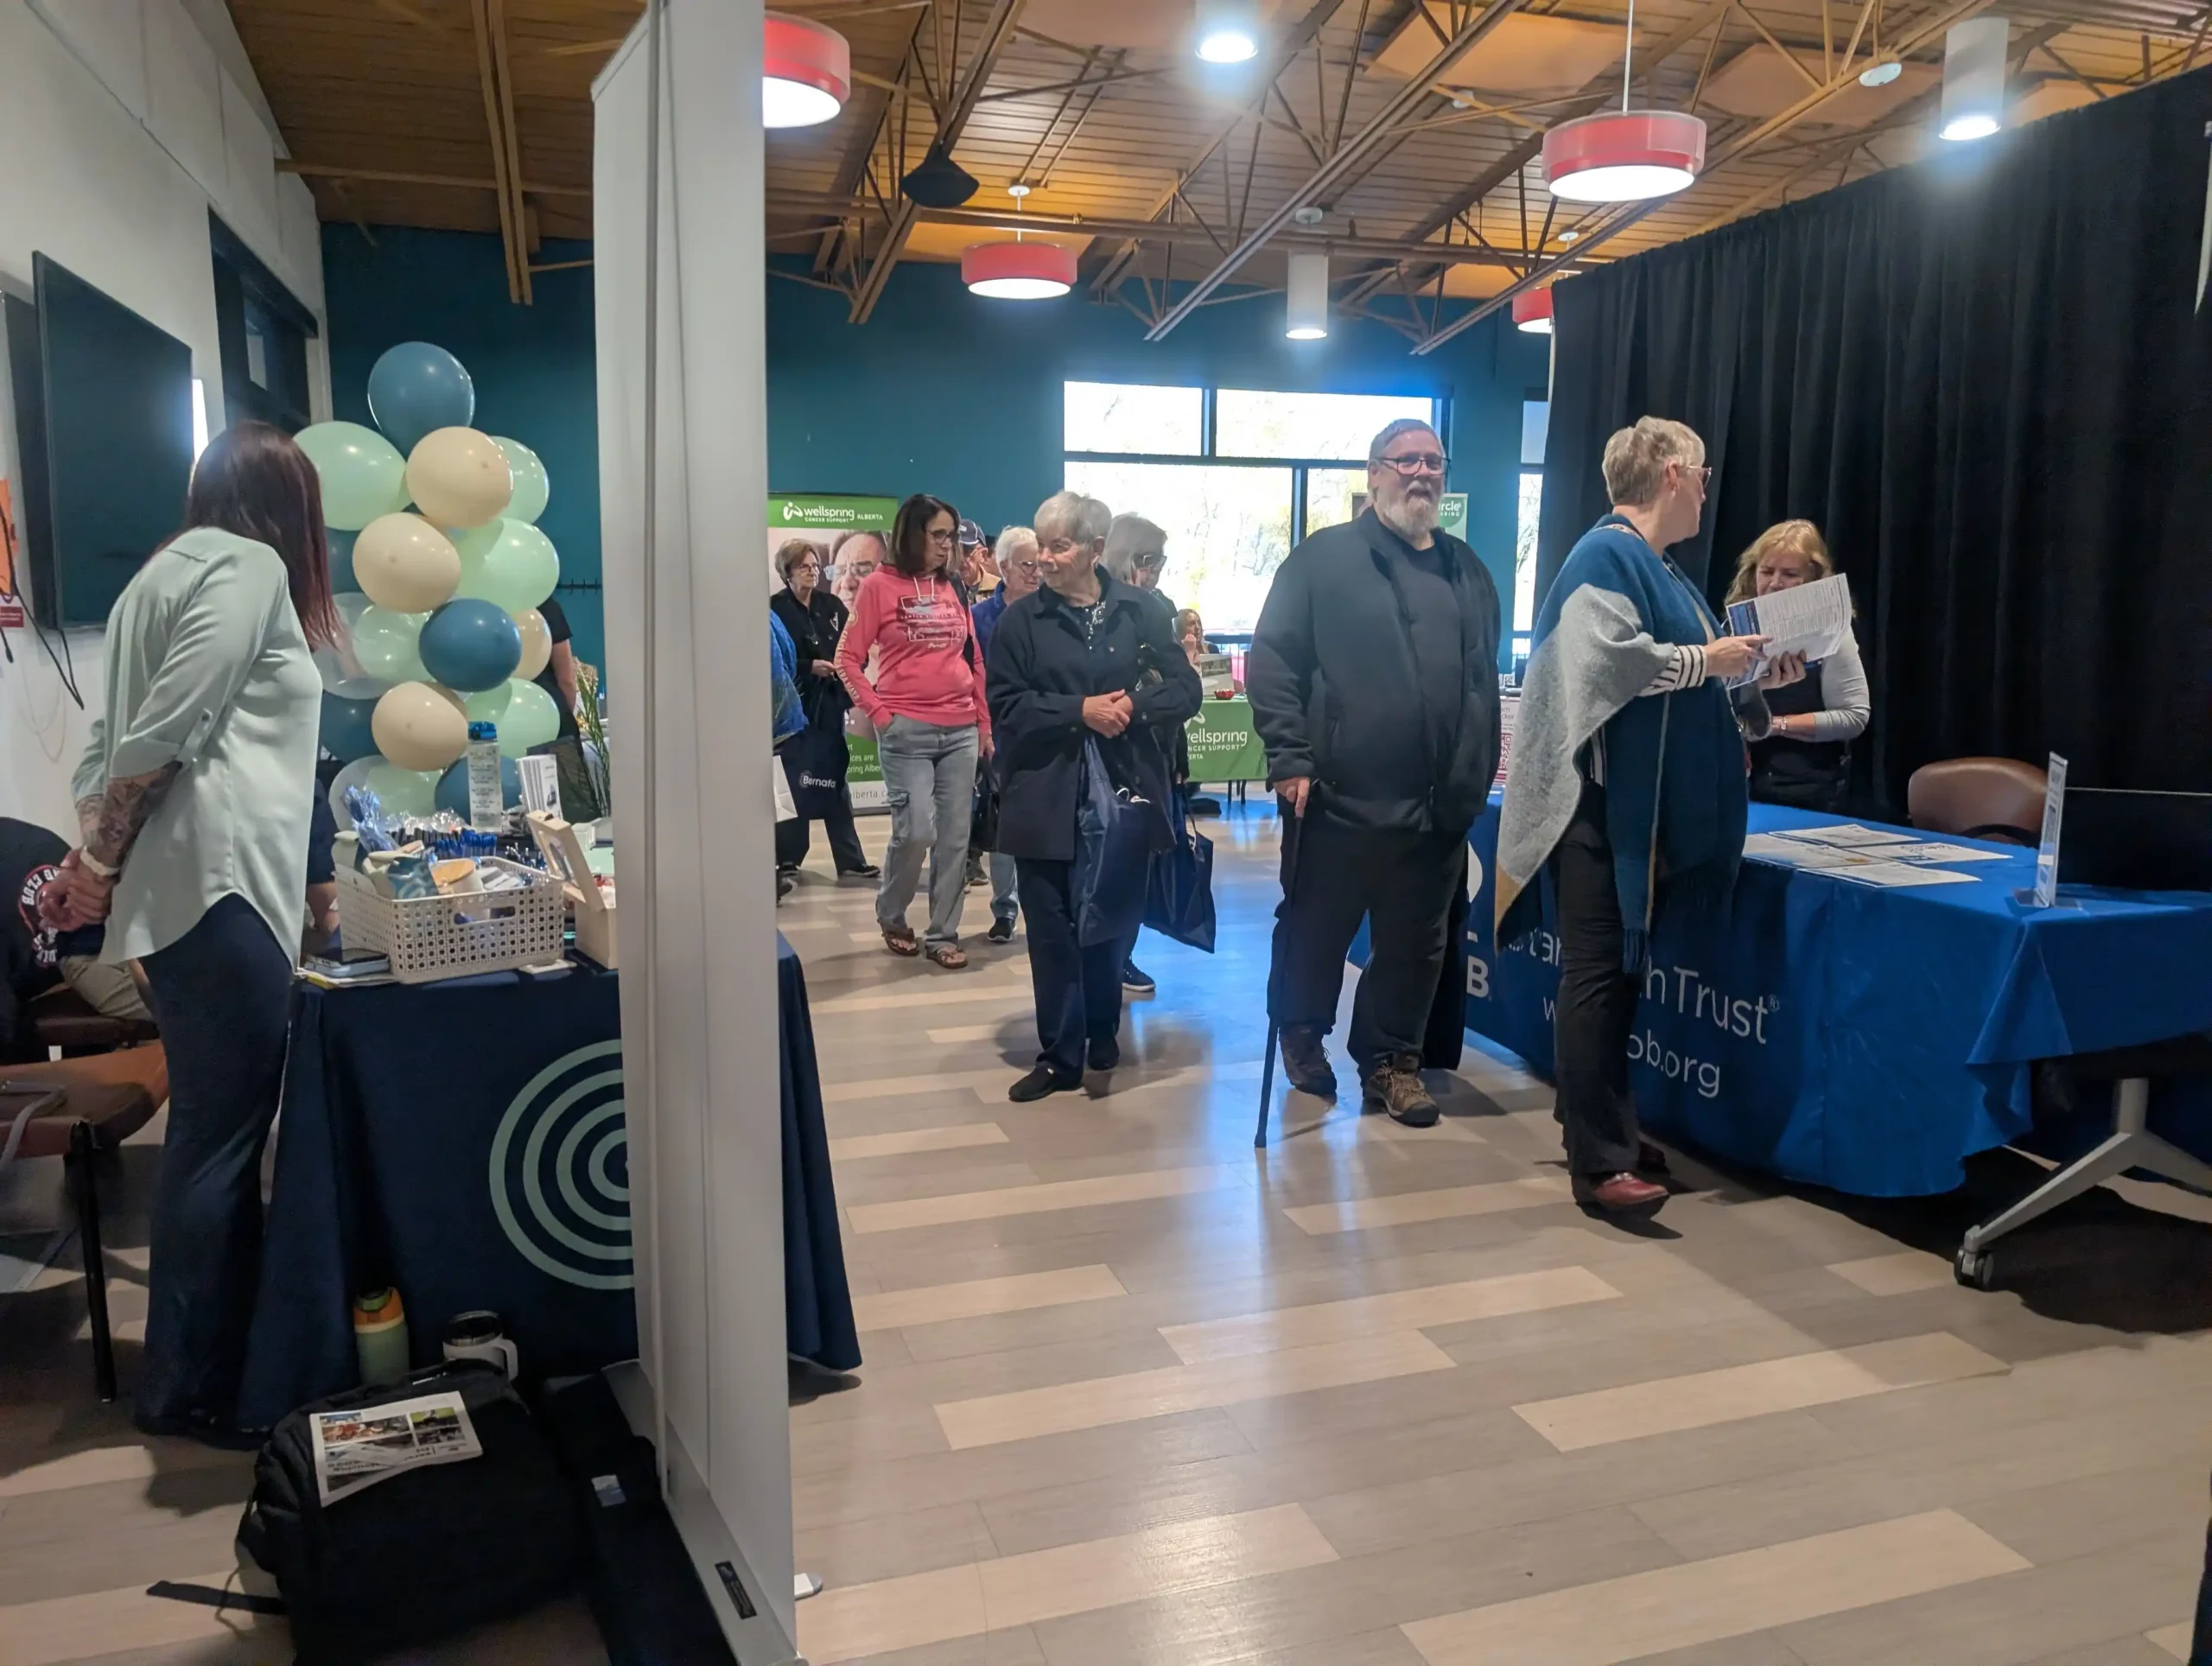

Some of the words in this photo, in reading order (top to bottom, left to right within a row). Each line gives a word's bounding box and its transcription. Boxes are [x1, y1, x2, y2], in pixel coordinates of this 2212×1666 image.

[804, 506, 855, 521] wellspring
[864, 764, 881, 773] Alber
[803, 775, 836, 788] Bernafo
